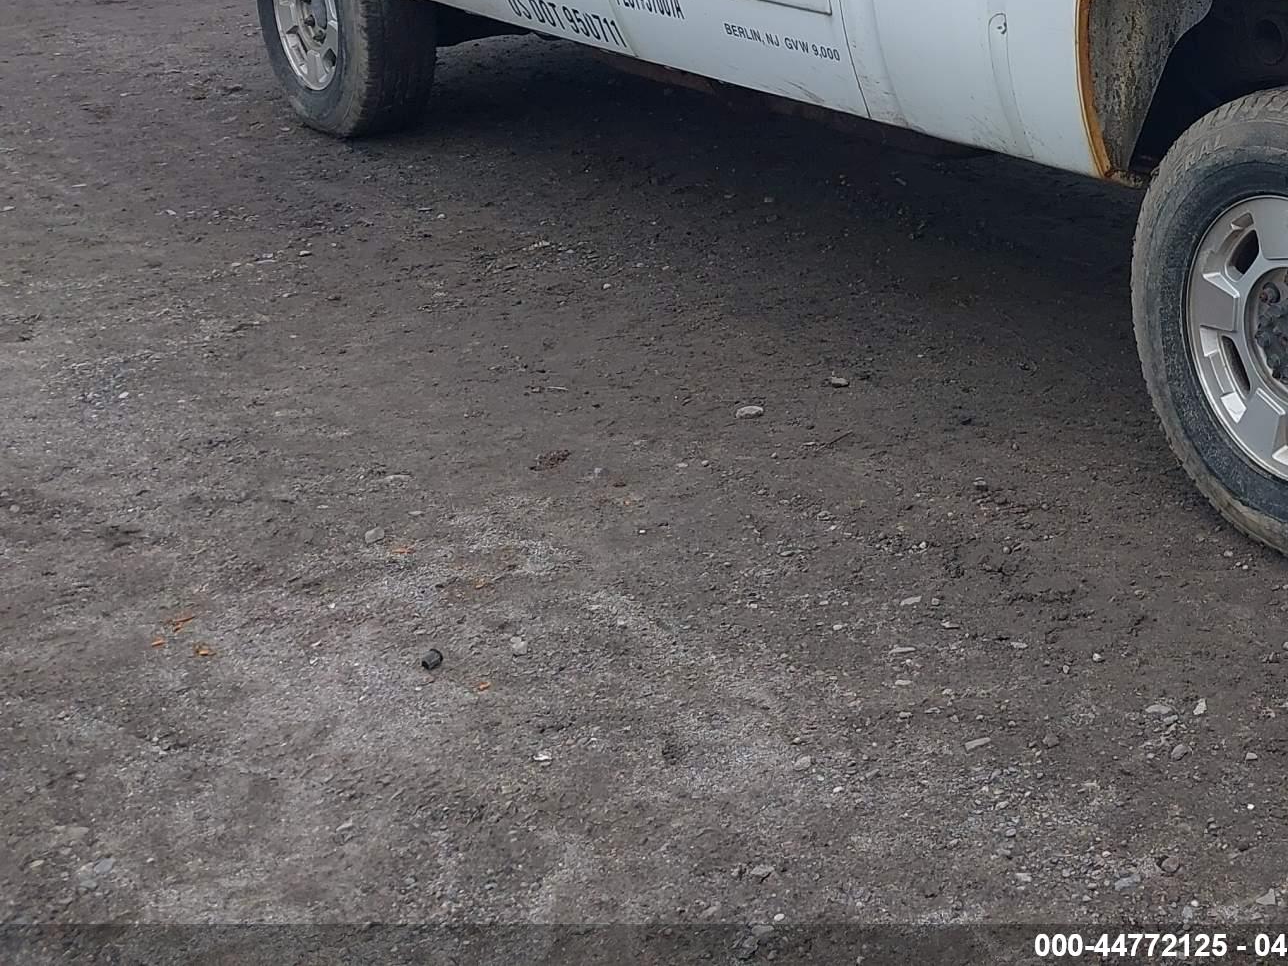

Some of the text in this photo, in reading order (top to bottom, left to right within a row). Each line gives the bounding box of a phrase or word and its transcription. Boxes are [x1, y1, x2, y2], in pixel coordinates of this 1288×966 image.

[562, 5, 627, 48] 950711
[724, 22, 841, 62] BERLIN, NJ GVW 9,000
